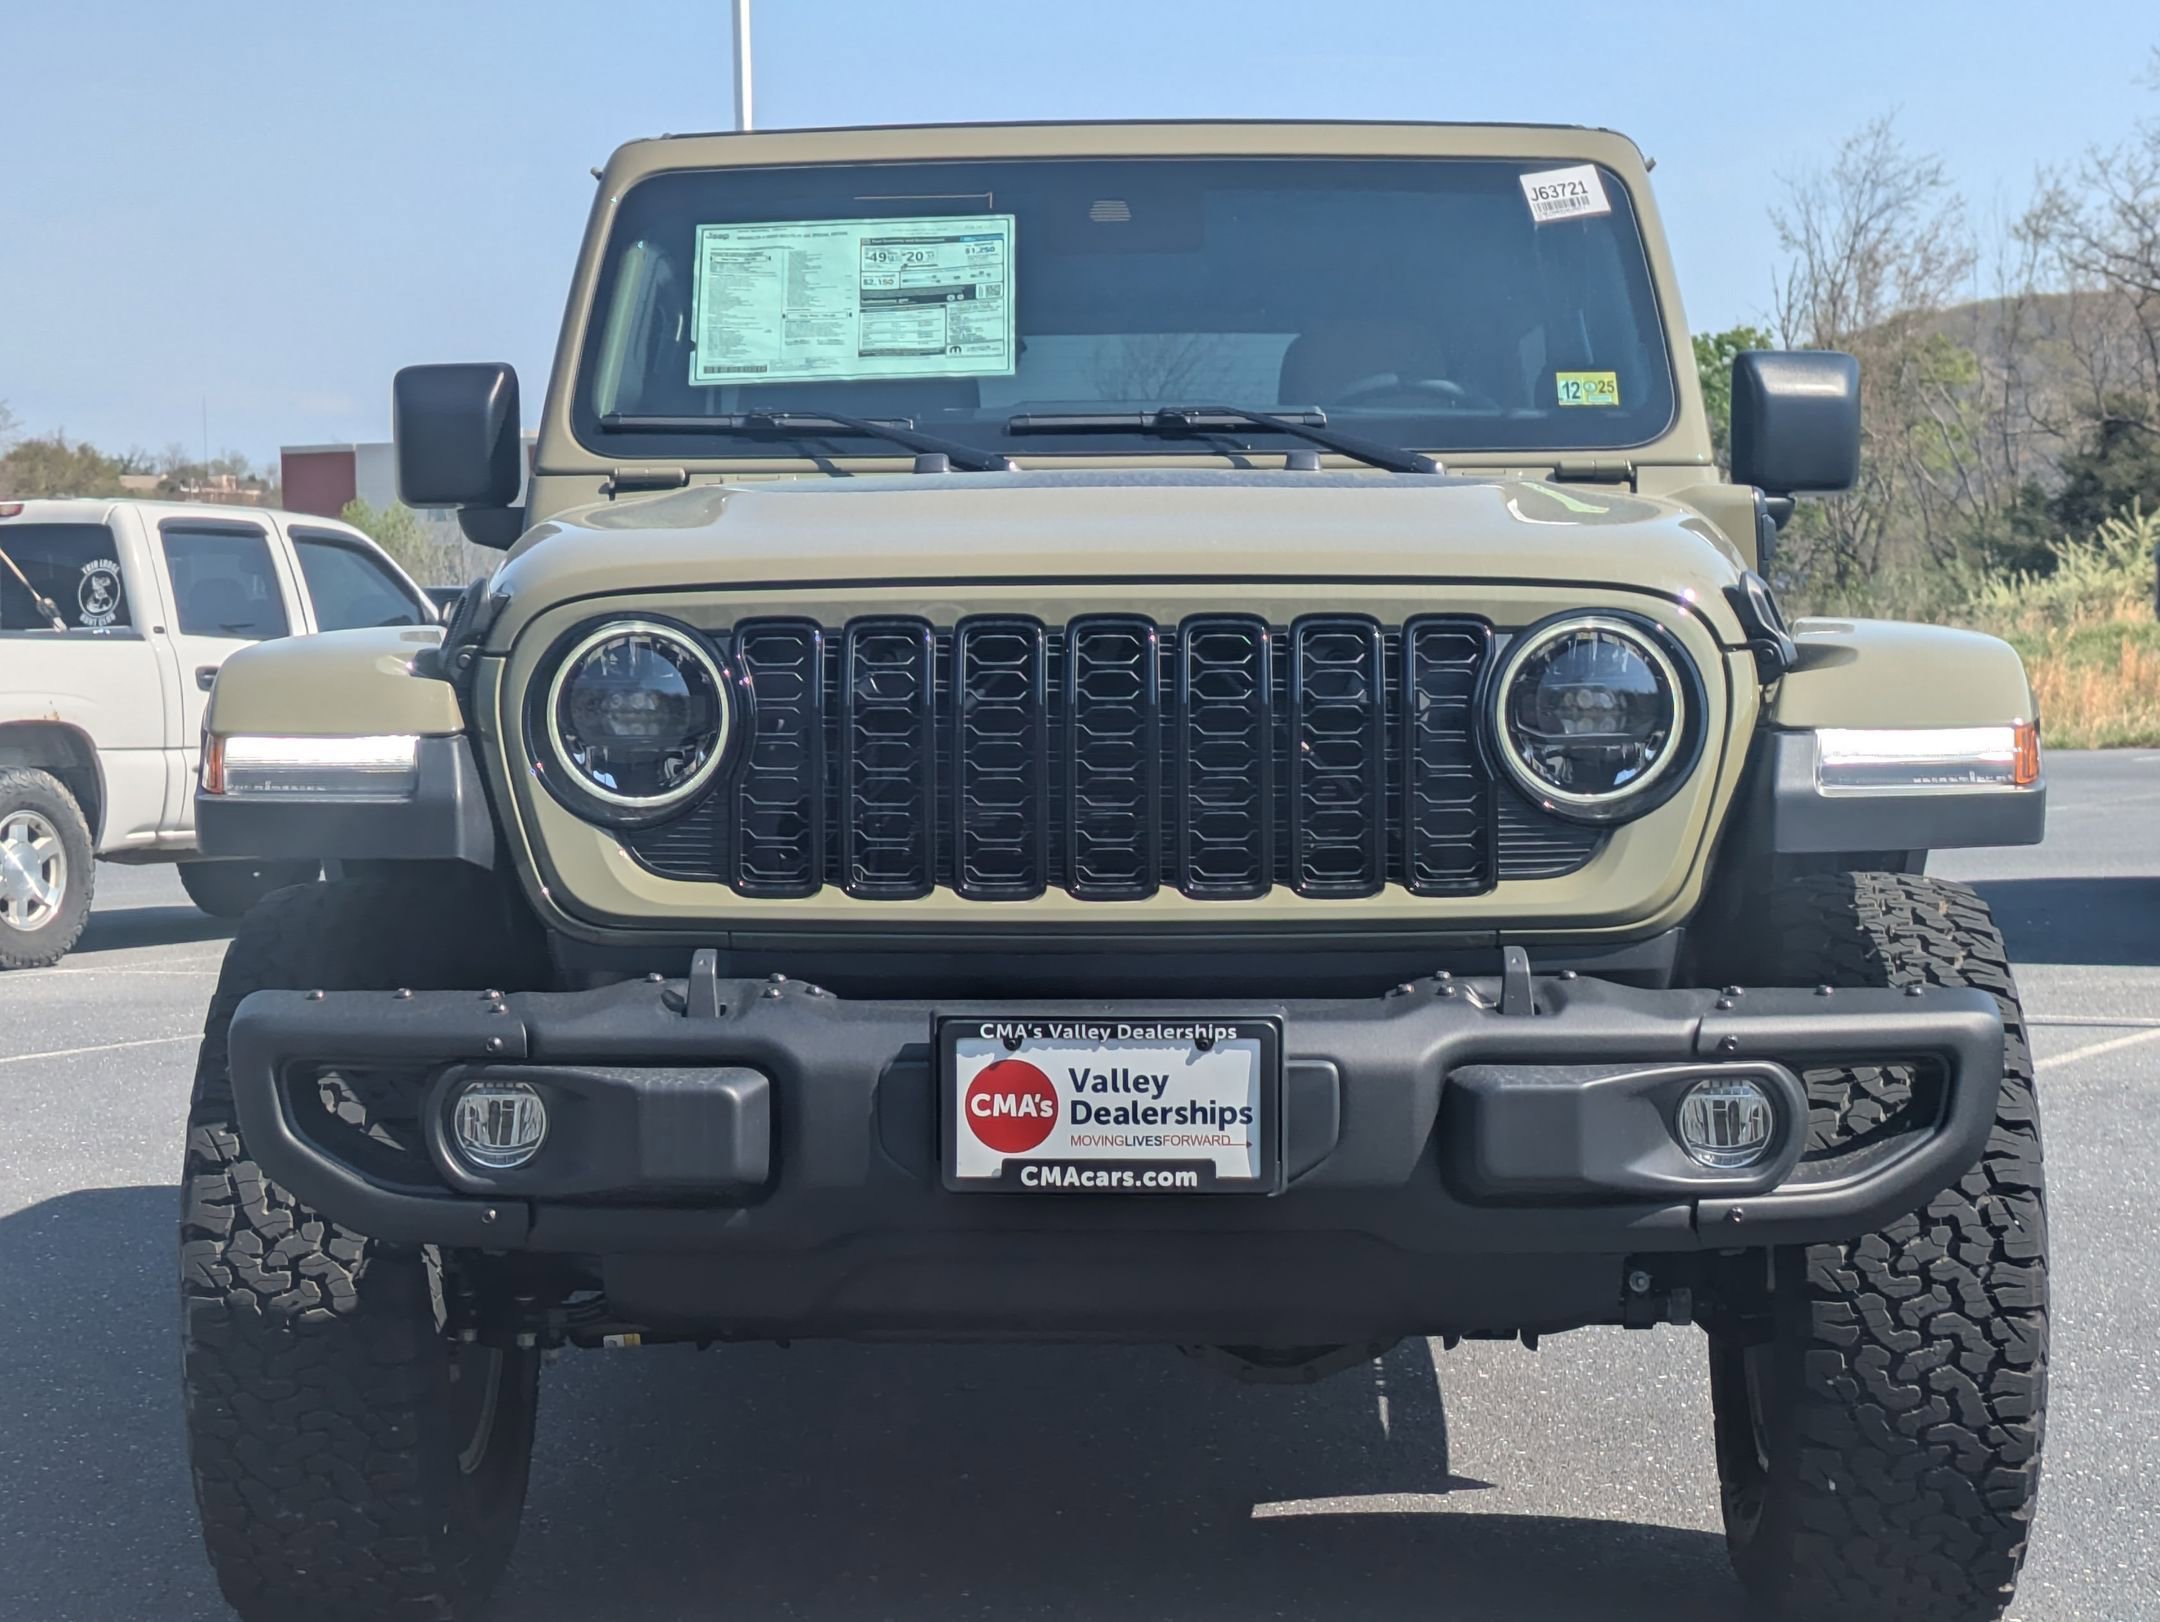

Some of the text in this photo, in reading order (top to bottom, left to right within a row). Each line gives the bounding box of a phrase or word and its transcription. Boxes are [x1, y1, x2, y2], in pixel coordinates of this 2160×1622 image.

[1531, 180, 1589, 202] J63721
[906, 251, 924, 262] 20
[1562, 381, 1581, 400] 12
[1598, 380, 1615, 394] 25
[980, 1023, 1237, 1043] CMA's Valley Dealerships
[1068, 1068, 1169, 1100] Valley
[970, 1094, 1053, 1118] CMA's
[1070, 1100, 1253, 1131] Dealerships
[1020, 1165, 1198, 1187] CMAcars.com
